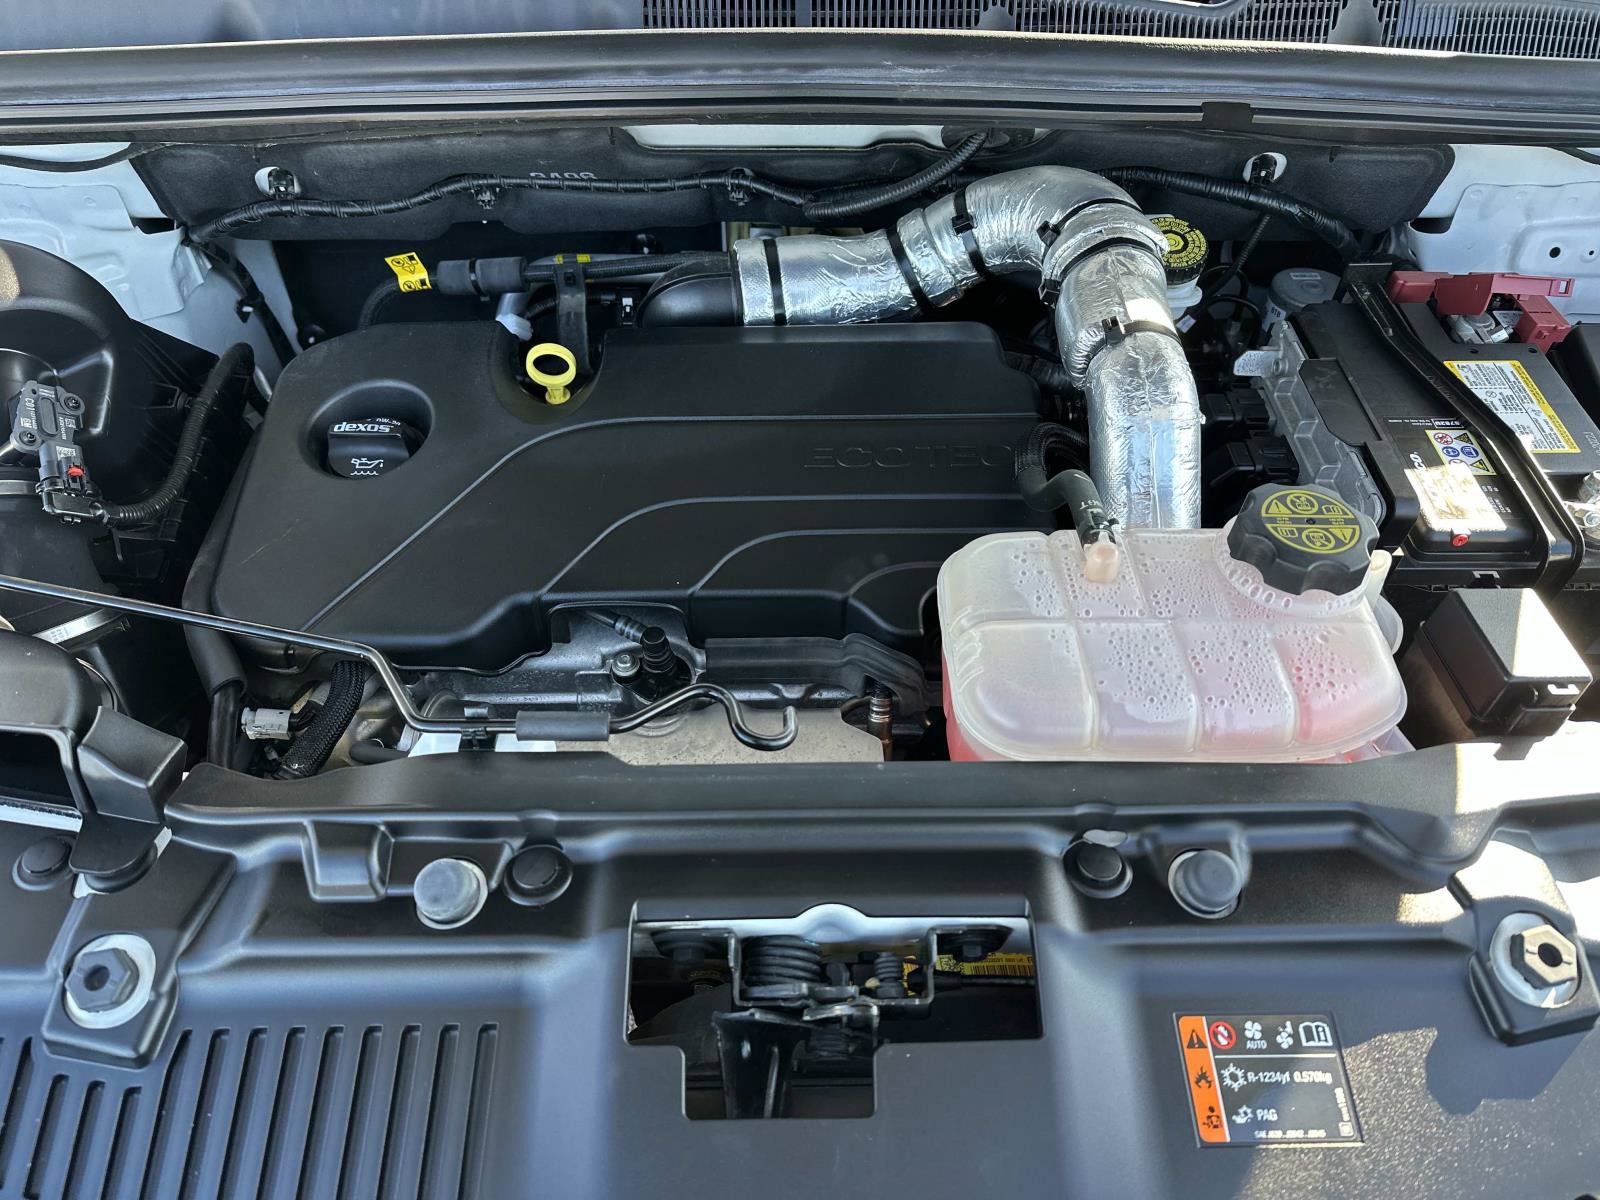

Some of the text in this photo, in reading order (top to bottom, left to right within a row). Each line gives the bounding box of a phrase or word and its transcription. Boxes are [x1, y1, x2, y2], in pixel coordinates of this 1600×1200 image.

[333, 421, 391, 433] dexos
[803, 446, 1012, 468] ECOTEC
[1246, 1039, 1268, 1050] AUTO
[1247, 1070, 1333, 1085] R-1234yf 0.570kg
[1256, 1108, 1279, 1122] PAG
